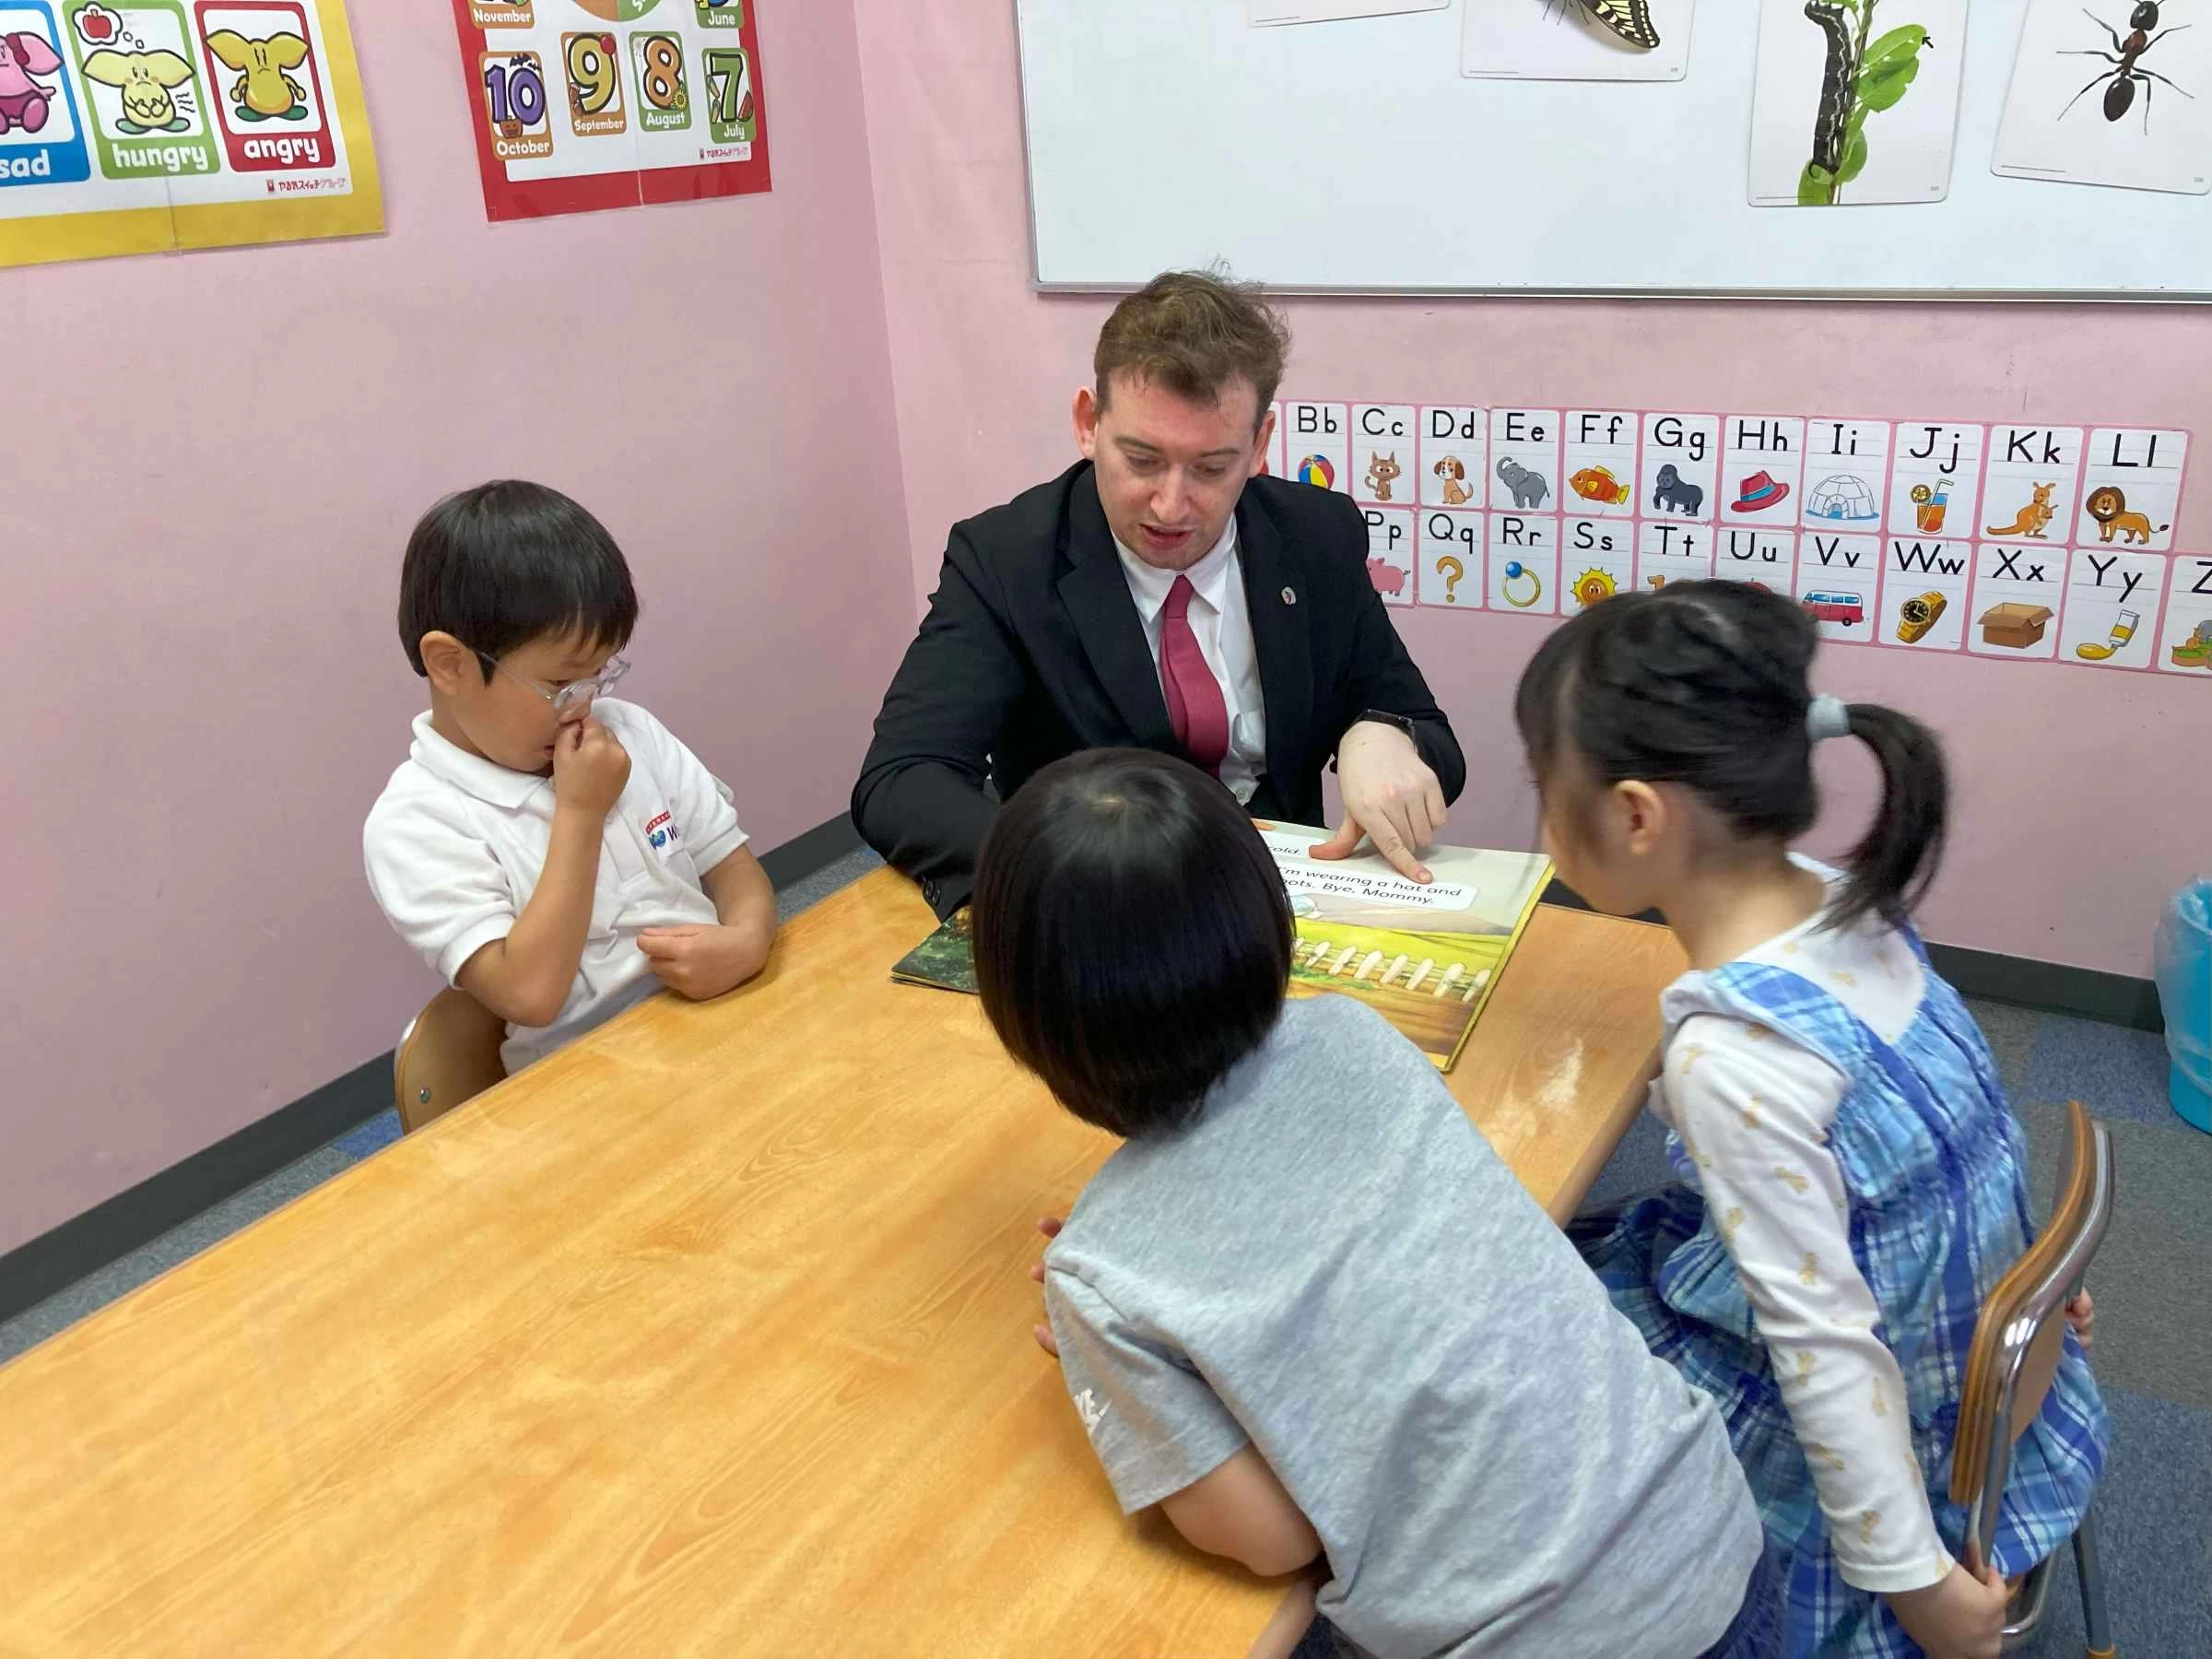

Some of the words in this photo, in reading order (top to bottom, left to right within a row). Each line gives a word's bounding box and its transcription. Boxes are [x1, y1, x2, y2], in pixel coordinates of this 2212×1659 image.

[474, 8, 532, 24] November
[708, 11, 735, 26] June
[568, 32, 617, 115] 9
[643, 35, 683, 110] 8
[485, 65, 547, 126] 10
[710, 53, 744, 123] 7
[574, 118, 625, 132] September
[646, 113, 686, 129] August
[724, 124, 745, 140] July
[112, 143, 209, 172] hungry
[244, 136, 320, 164] angry
[497, 140, 550, 156] October
[0, 148, 51, 179] sad
[1306, 870, 1372, 887] wearing
[1394, 881, 1422, 892] hat
[1427, 888, 1463, 897] and
[1362, 888, 1435, 905] Mommy.
